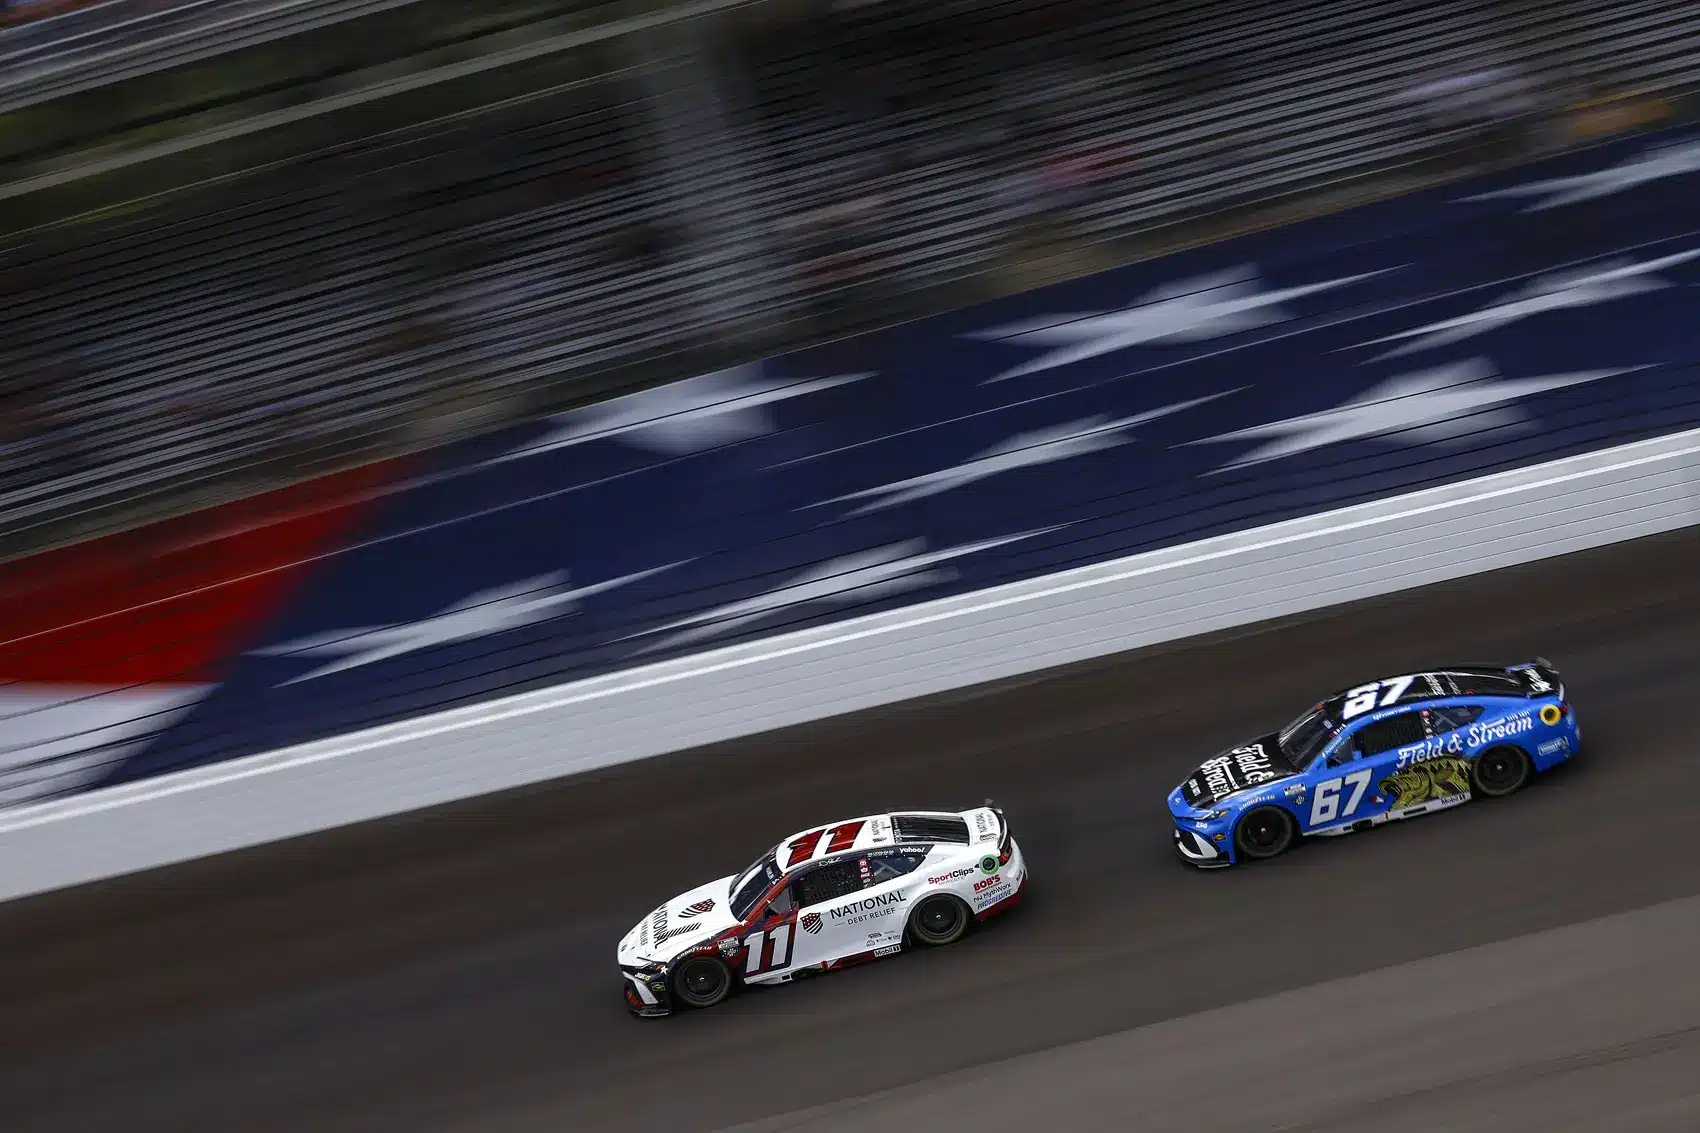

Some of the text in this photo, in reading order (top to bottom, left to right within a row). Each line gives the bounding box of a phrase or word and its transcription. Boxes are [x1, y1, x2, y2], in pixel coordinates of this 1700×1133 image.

[1342, 675, 1415, 720] 67
[1232, 743, 1272, 773] Field
[1396, 738, 1444, 769] Field
[1446, 733, 1465, 757] &
[1467, 716, 1533, 748] Stream
[1200, 756, 1240, 802] Stream
[1309, 767, 1373, 827] 67
[785, 819, 868, 869] 11
[899, 846, 926, 854] yahoo!
[973, 874, 1001, 892] BOB'S
[829, 889, 906, 920] NATIONAL
[847, 907, 896, 926] DEBT RELIEF
[743, 924, 796, 975] 11
[875, 947, 893, 956] Mobil
